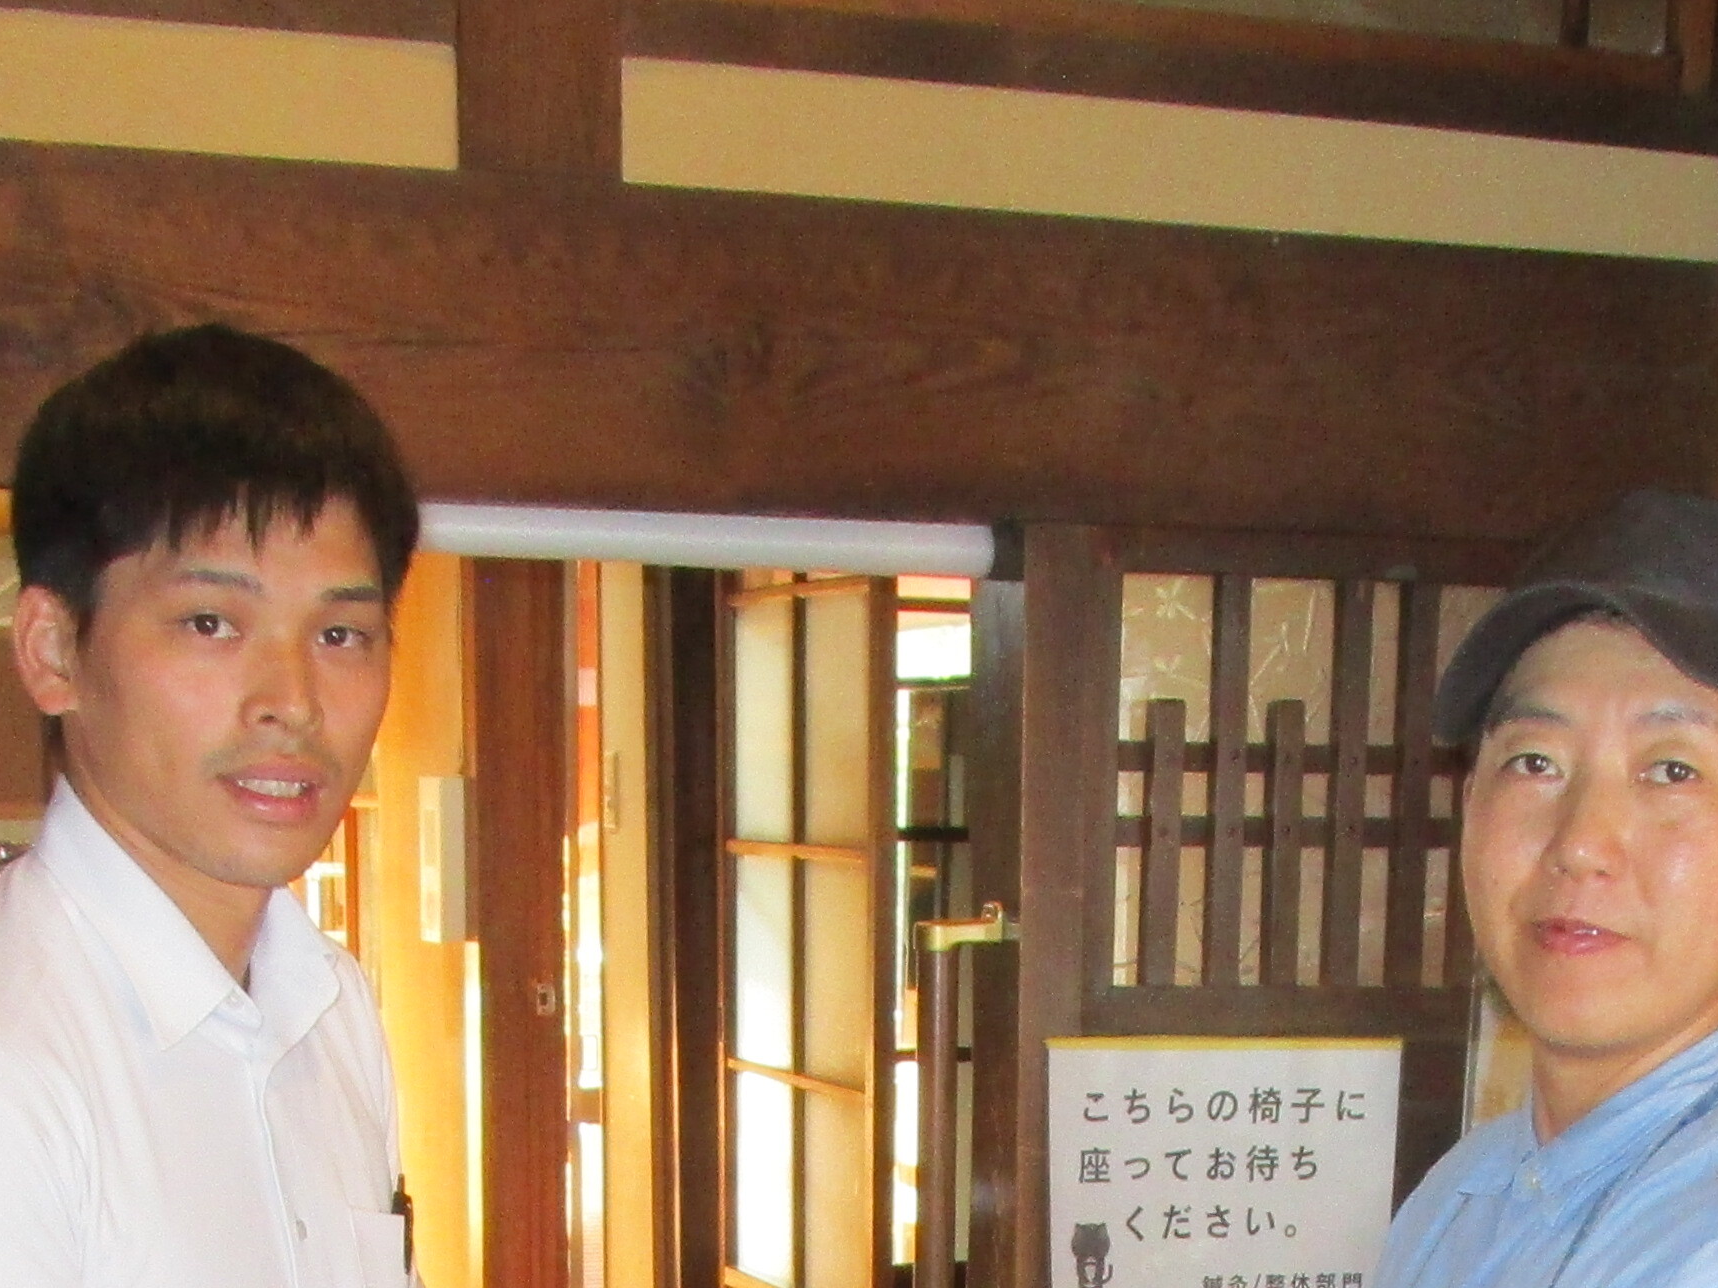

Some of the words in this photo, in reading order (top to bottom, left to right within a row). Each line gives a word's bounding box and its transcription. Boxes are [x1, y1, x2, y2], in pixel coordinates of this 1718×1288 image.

[1082, 1086, 1367, 1125] こちらの椅子に
[1078, 1147, 1319, 1184] 座ってお待ち
[1124, 1204, 1298, 1241] ください。
